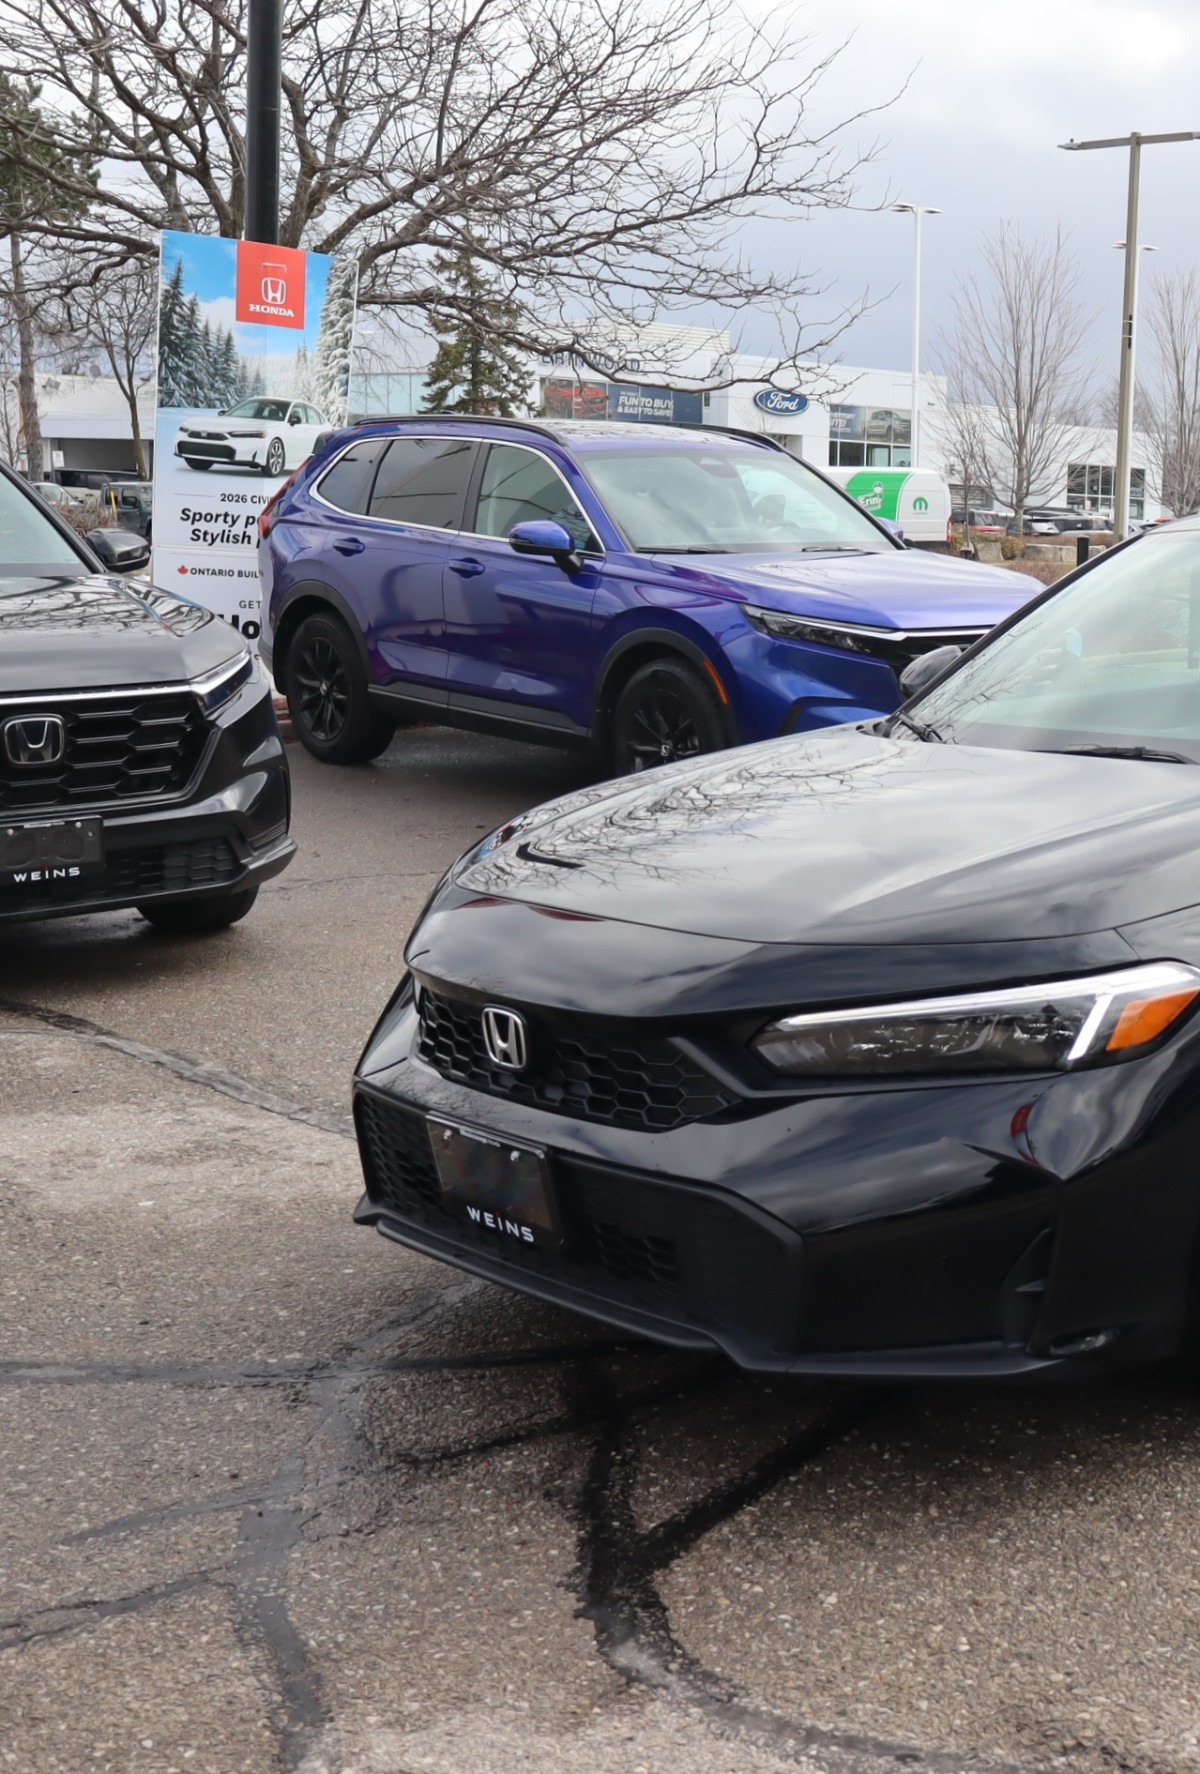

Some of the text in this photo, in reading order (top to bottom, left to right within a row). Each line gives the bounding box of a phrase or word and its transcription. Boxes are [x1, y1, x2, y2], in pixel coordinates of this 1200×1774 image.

[248, 303, 296, 318] HONDA
[618, 395, 639, 406] FUN
[640, 397, 653, 407] TO
[767, 391, 799, 411] Ford
[220, 493, 248, 503] 2026
[179, 507, 242, 528] Sporty
[190, 528, 252, 547] Stylish
[190, 567, 259, 579] ONTARIO BUIL
[239, 600, 262, 610] GET
